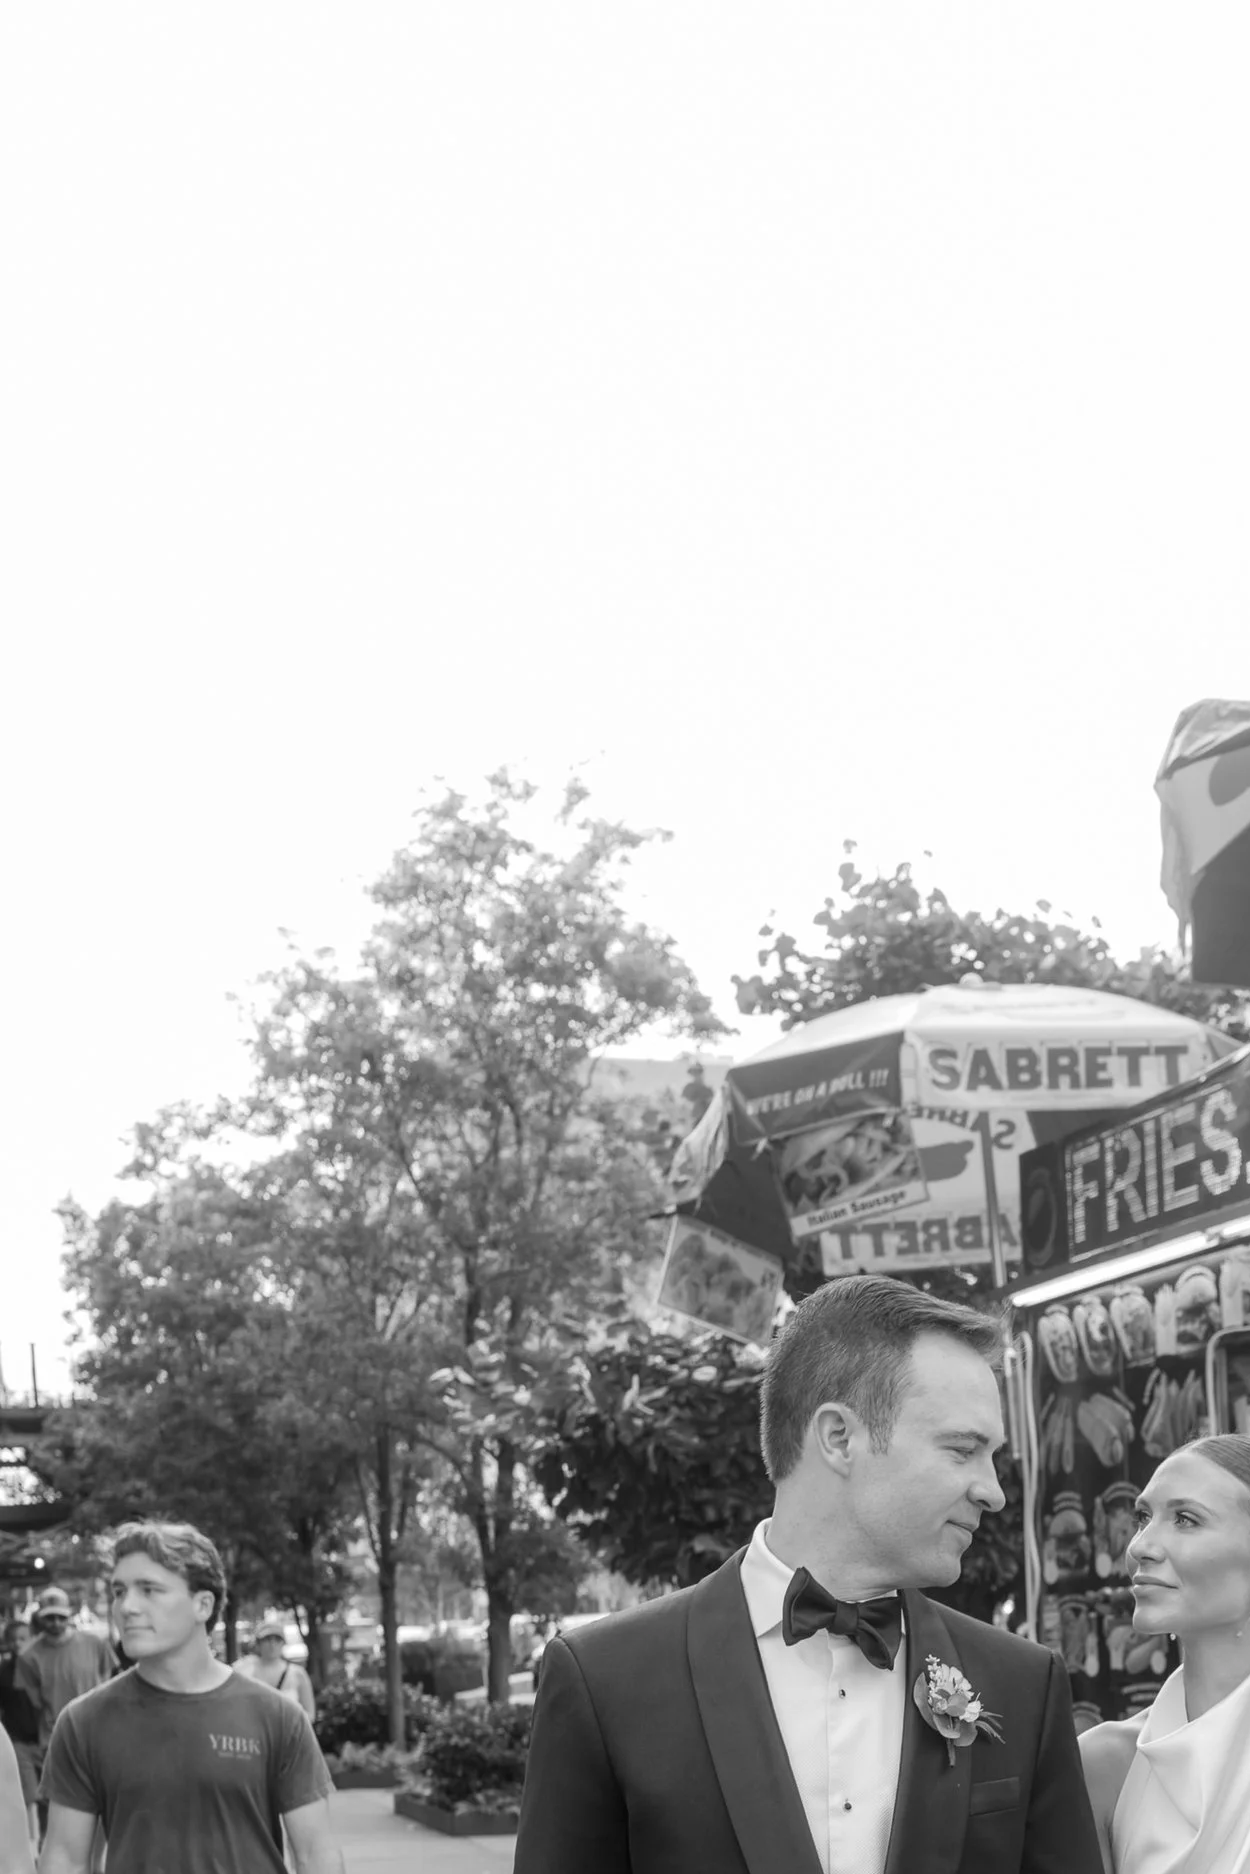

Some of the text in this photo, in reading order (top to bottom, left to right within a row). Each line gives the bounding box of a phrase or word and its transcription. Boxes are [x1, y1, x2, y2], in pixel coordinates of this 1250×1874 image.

[928, 1044, 1190, 1092] SABRETT
[806, 1188, 908, 1229] Italian Sausage
[208, 1732, 262, 1755] YRBK
